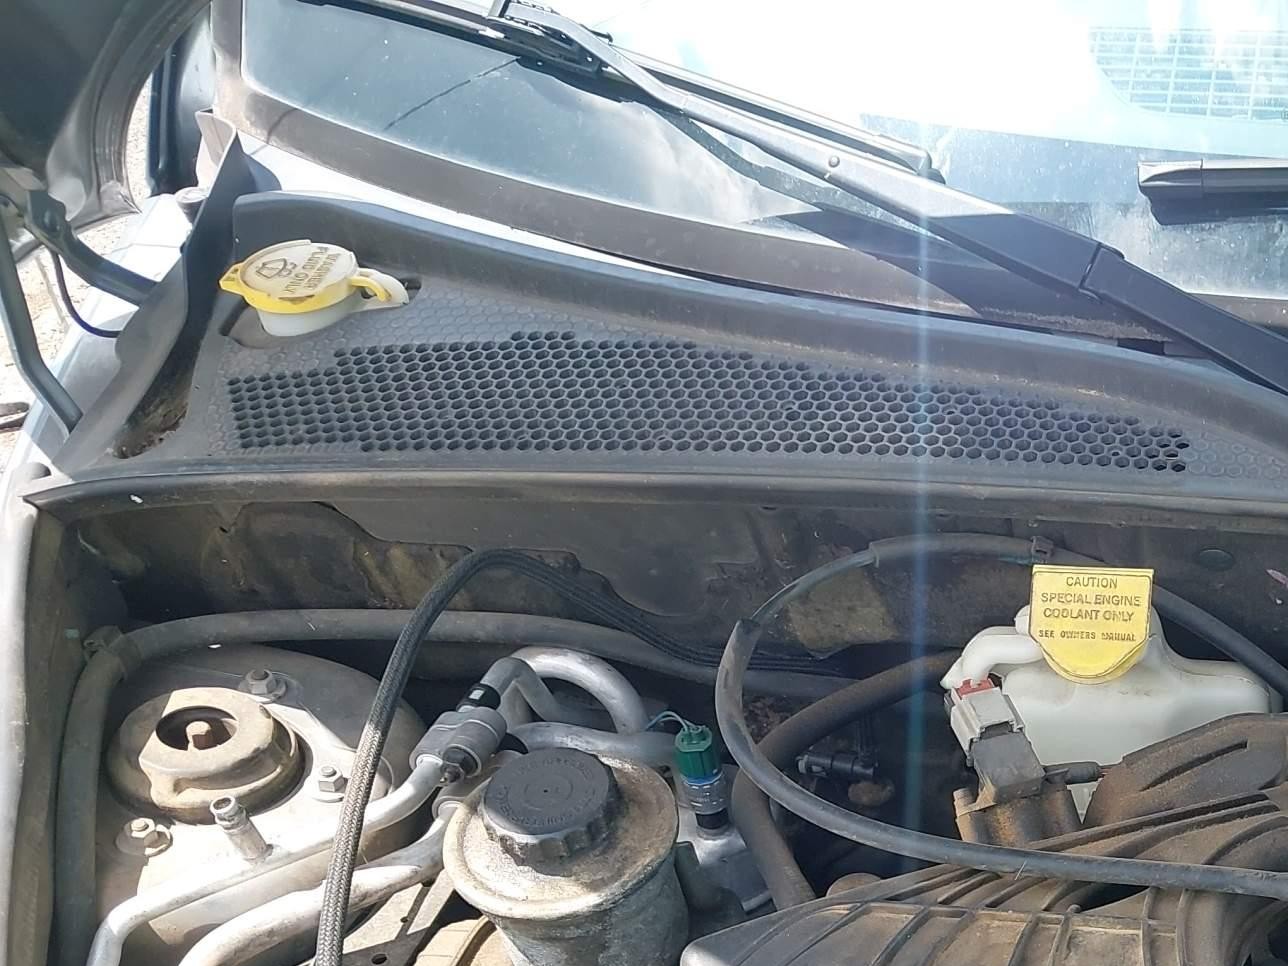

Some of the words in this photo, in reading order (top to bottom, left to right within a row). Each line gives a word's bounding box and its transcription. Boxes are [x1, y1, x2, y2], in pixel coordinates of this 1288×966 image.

[1066, 576, 1118, 589] CAUTION
[1041, 592, 1092, 605] SPECIAL
[1094, 594, 1142, 607] ENGINE
[1043, 607, 1100, 620] COOLANT
[1103, 610, 1135, 622] ONLY
[1038, 630, 1055, 639] SEE
[1060, 630, 1096, 640] OWNERS
